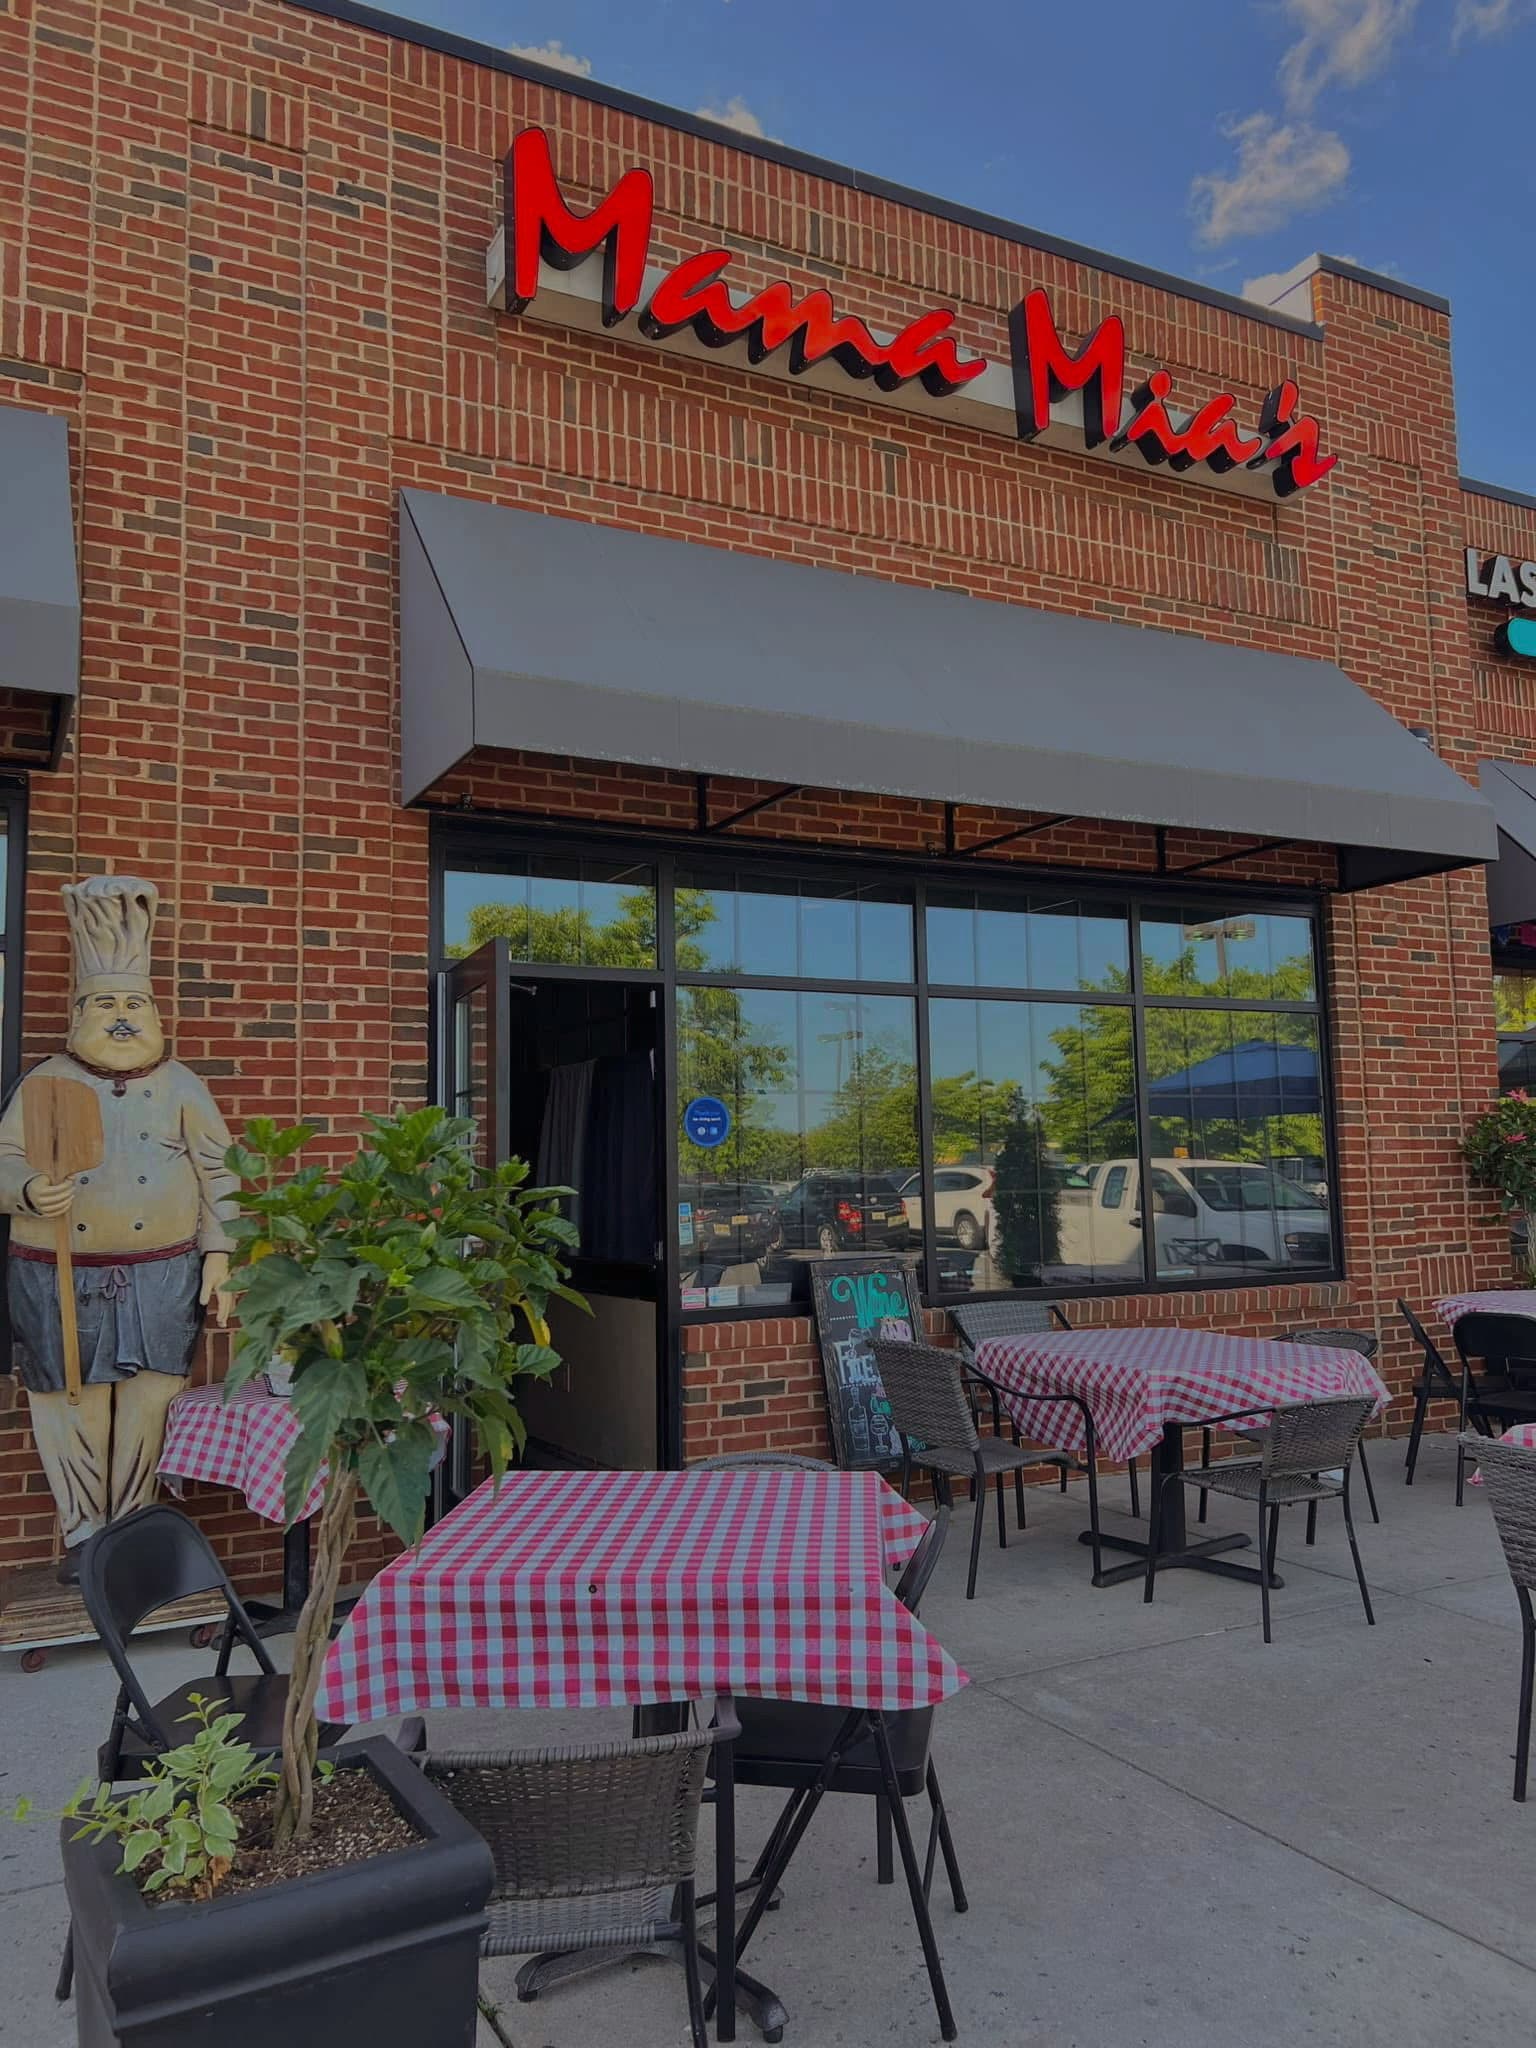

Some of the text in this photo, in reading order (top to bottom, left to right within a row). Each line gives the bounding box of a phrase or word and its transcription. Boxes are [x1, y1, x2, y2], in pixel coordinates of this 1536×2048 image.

[511, 128, 1338, 488] Mama Mia's
[831, 1273, 909, 1328] Wine
